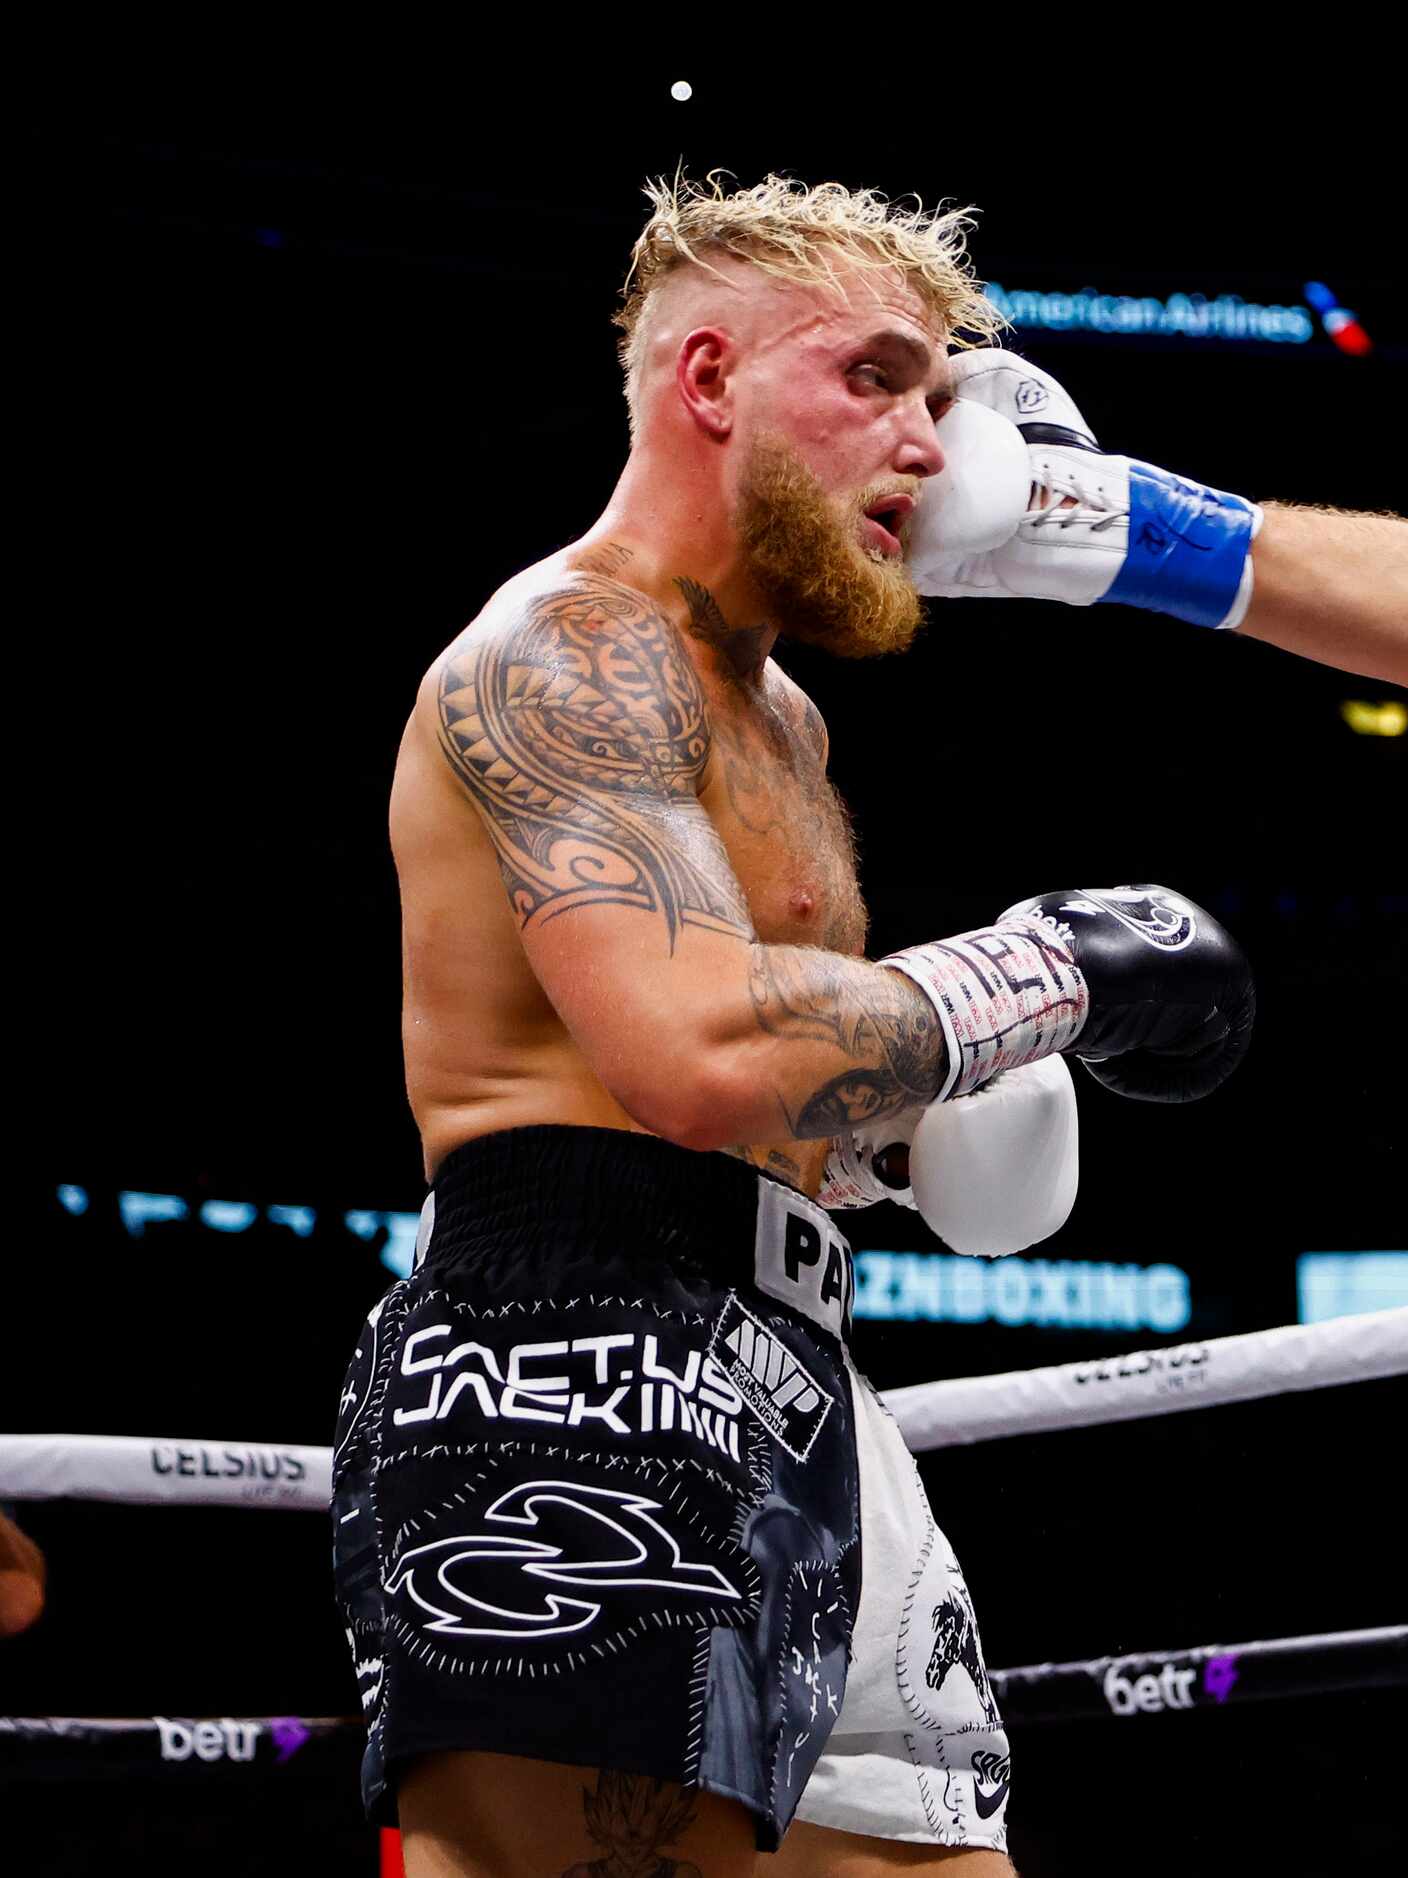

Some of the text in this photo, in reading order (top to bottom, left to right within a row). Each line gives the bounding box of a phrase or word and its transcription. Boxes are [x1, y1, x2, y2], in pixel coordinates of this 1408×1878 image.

[729, 1366, 784, 1437] PROMOTIONS
[731, 1358, 790, 1430] MOST VALUABLE
[151, 1448, 306, 1481] CELSIUS
[1104, 1664, 1197, 1715] betr
[155, 1717, 262, 1762] betr
